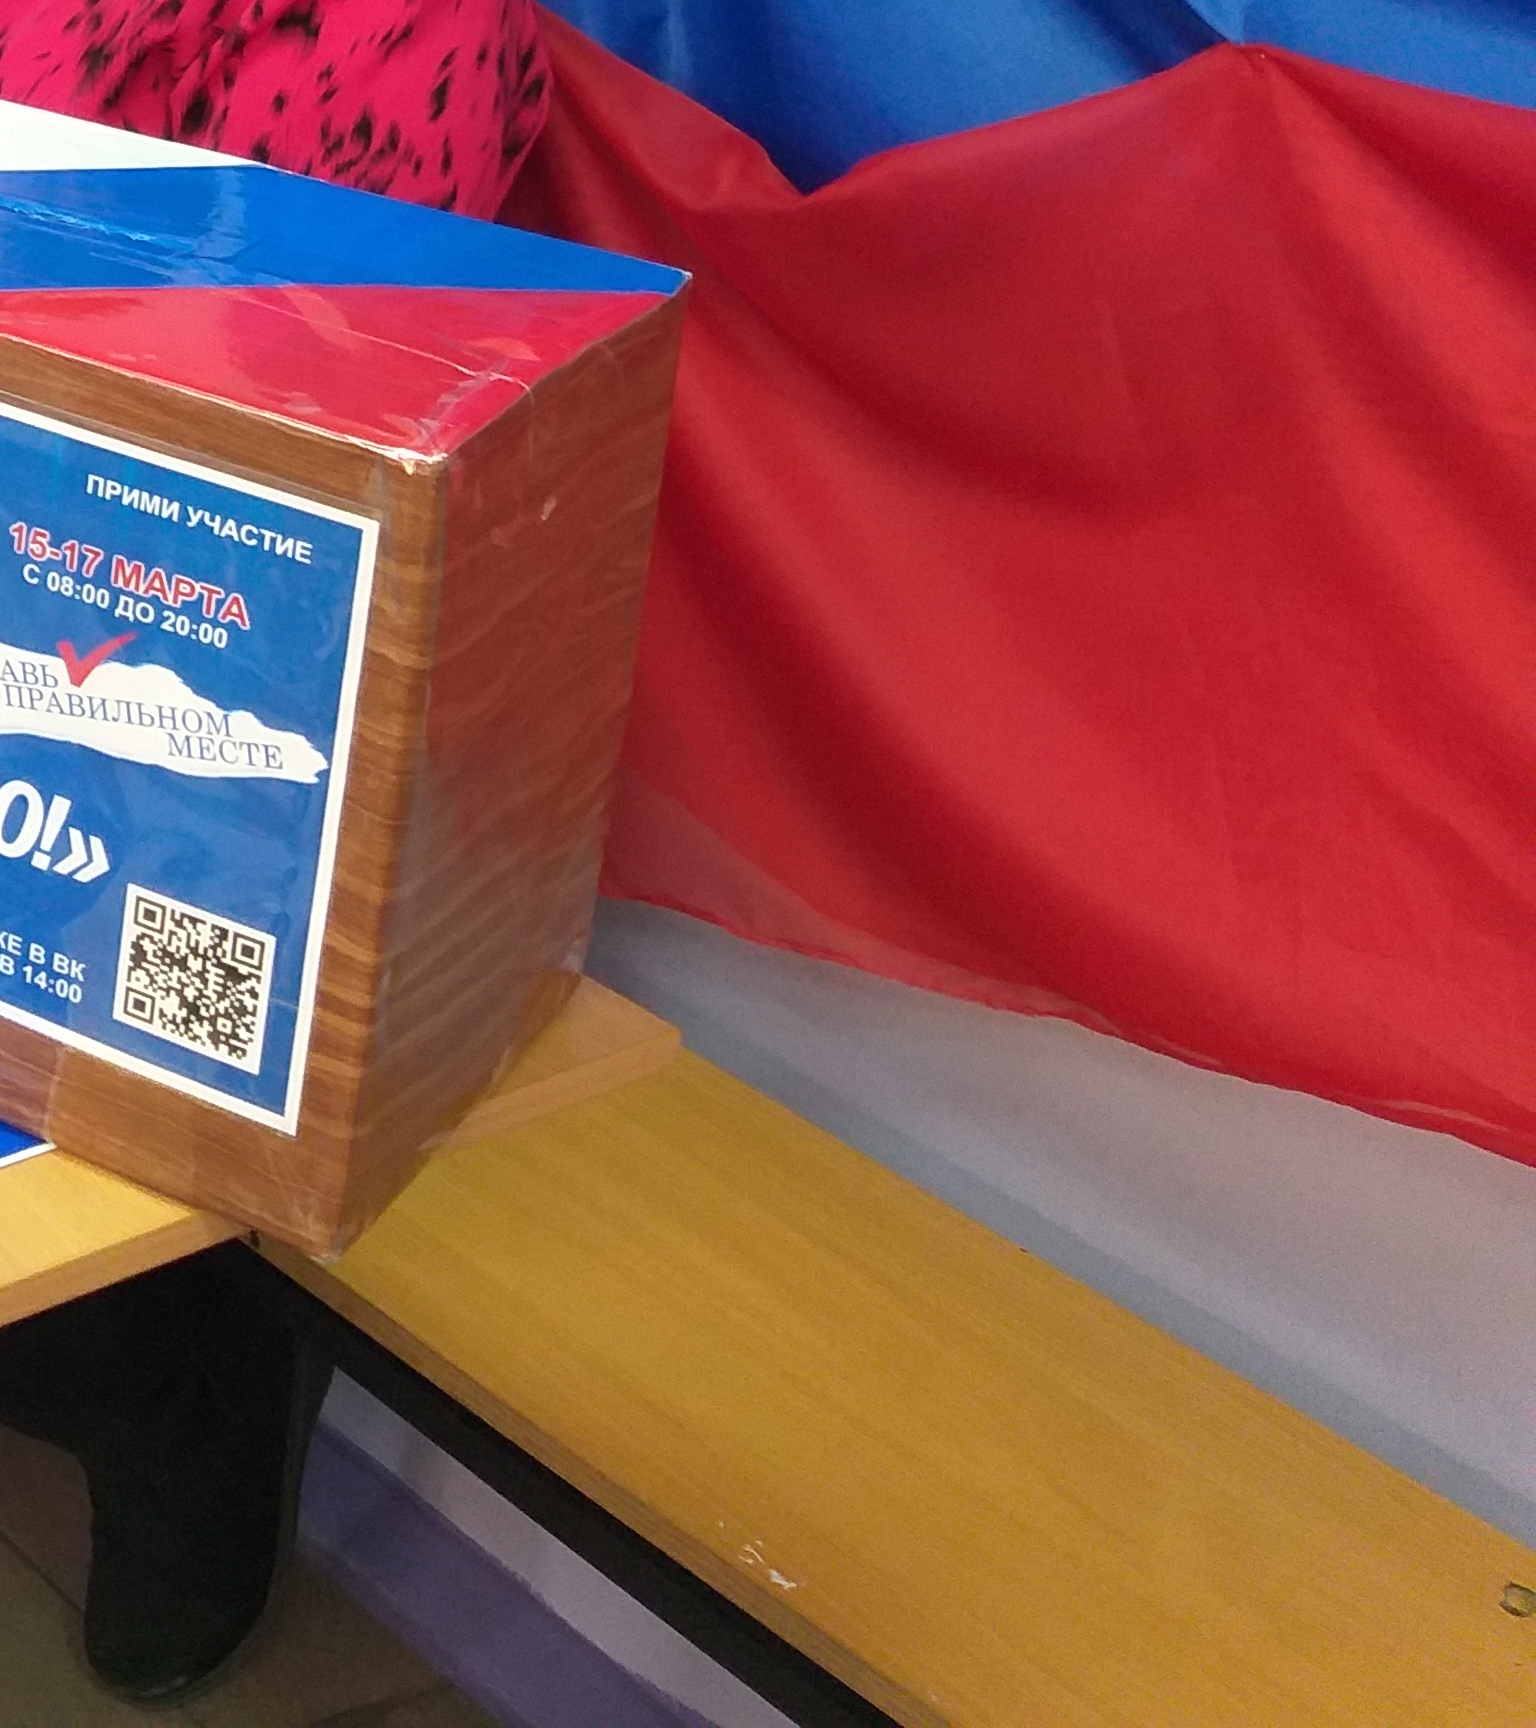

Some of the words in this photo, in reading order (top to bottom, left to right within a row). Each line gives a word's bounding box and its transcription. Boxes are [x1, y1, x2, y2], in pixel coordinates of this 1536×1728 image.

[87, 473, 180, 522] ПРИМИ
[186, 505, 314, 564] УЧАСТИЕ
[9, 521, 103, 578] 15-17
[111, 556, 251, 629] МАРТА
[23, 564, 41, 585] С
[46, 571, 110, 609] 08:00
[115, 597, 155, 624] ДО
[162, 610, 228, 649] 20:00
[5, 685, 234, 738] ПРАВИЛЬНОМ
[167, 733, 284, 770] МЕСТЕ
[23, 965, 83, 1003] 14:00
[29, 942, 46, 965] В
[52, 952, 86, 982] ВК
